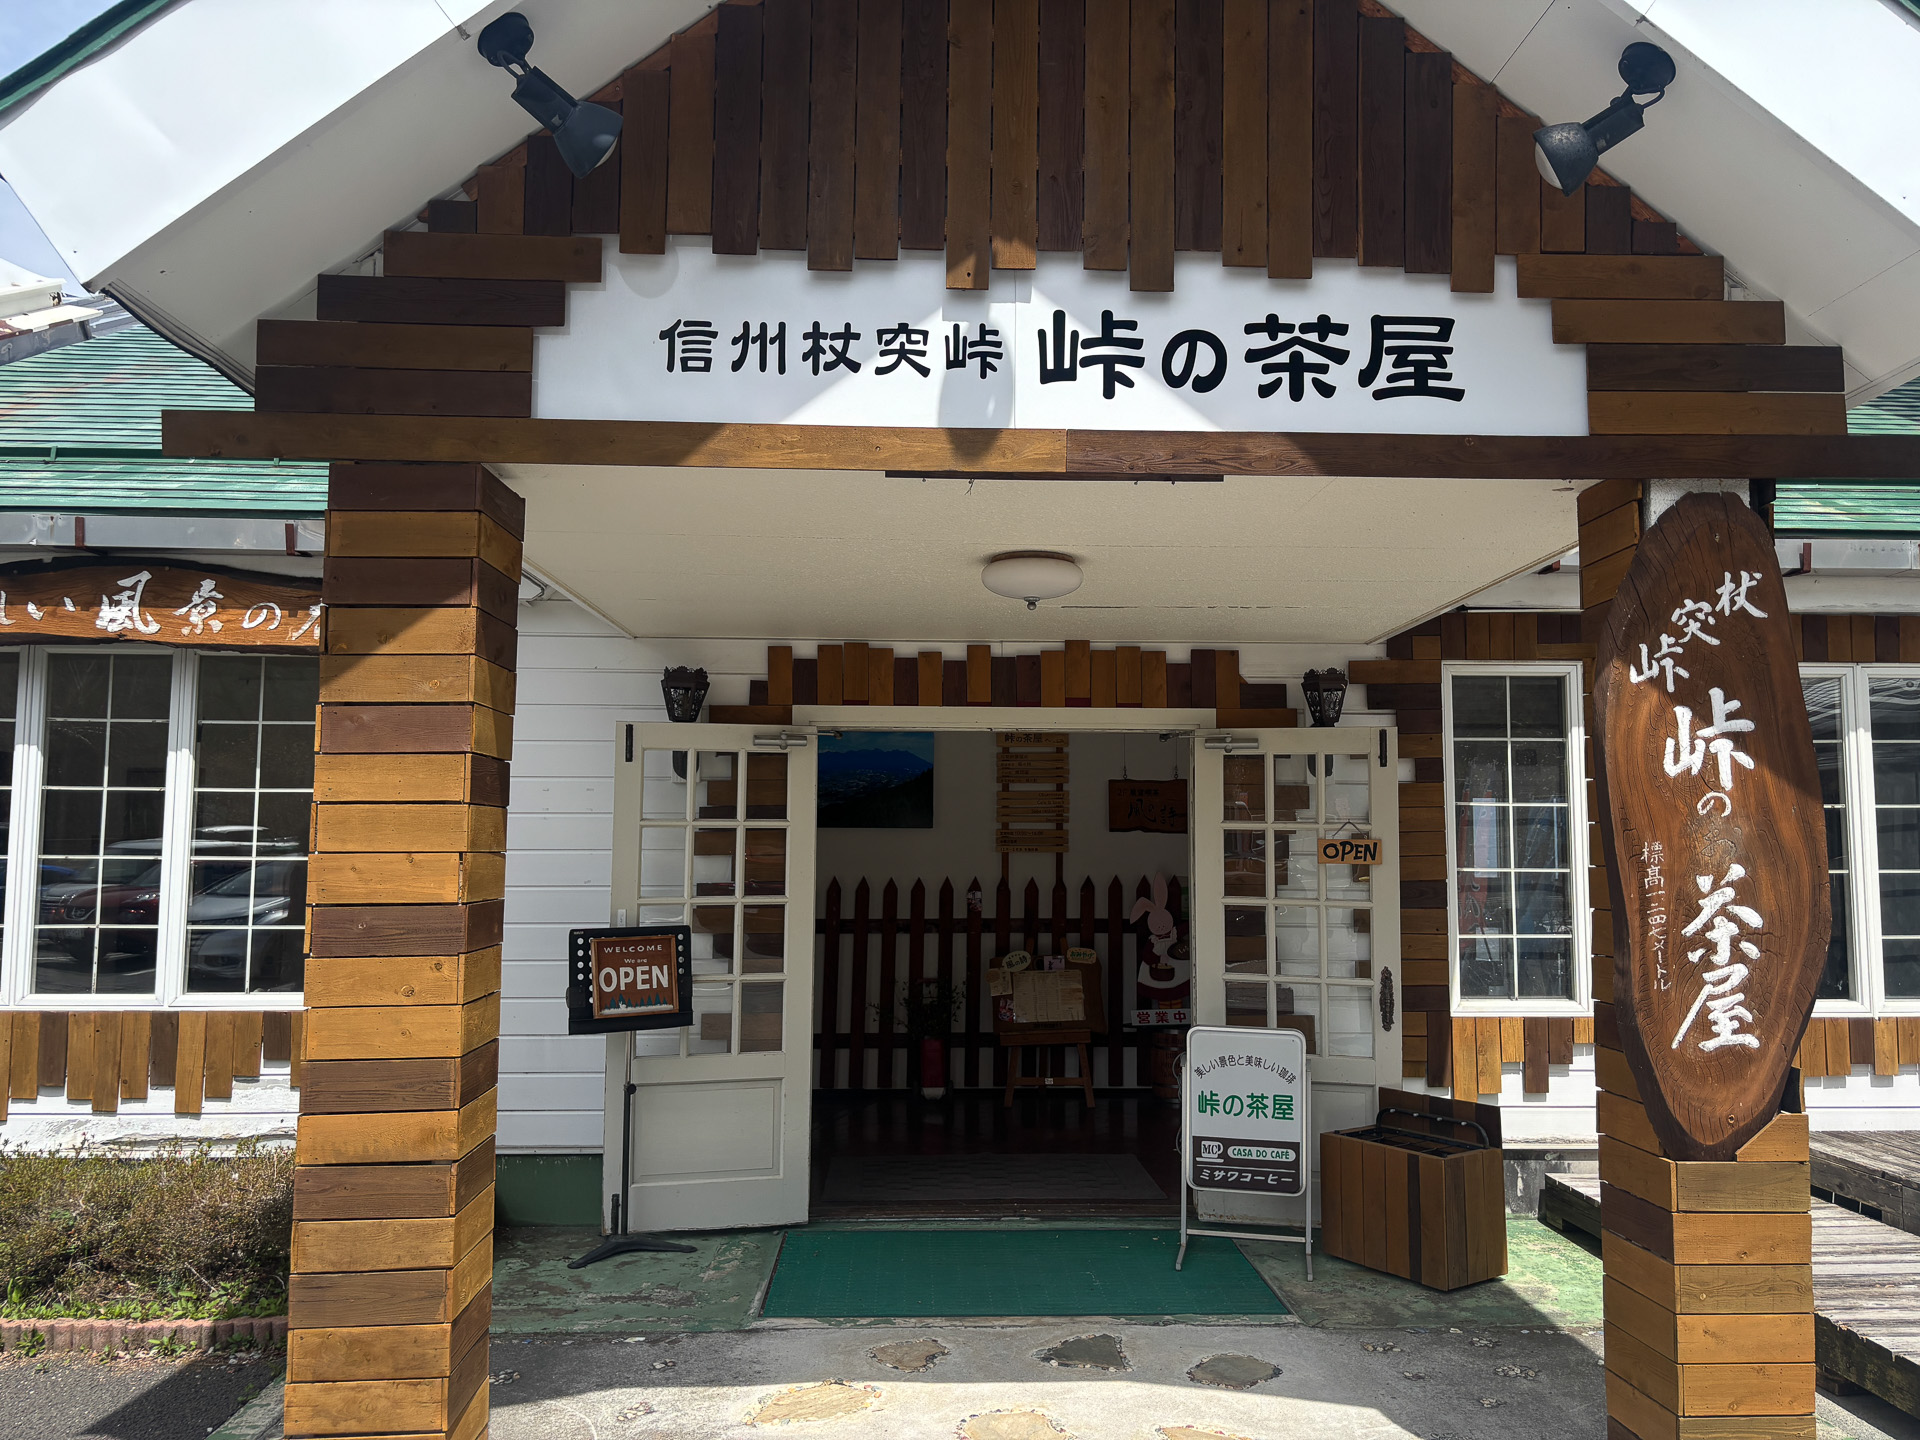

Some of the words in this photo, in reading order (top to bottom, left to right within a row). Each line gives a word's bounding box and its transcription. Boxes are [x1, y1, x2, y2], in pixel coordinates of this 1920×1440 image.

[660, 319, 1003, 379] 信州杖突峠
[1038, 309, 1466, 402] 峠の茶屋
[1629, 571, 1768, 693] 杖突峠
[1323, 840, 1378, 861] OPEN
[604, 944, 663, 953] WELCOME
[599, 965, 669, 993] OPEN
[1136, 1011, 1187, 1024] 営業中
[1194, 1054, 1297, 1085] 美しい景色と美味しい珈琲
[1198, 1090, 1295, 1121] 峠の茶屋
[1232, 1148, 1253, 1158] CASA
[1256, 1150, 1267, 1158] DO
[1200, 1169, 1293, 1184] ミサワコーヒー
